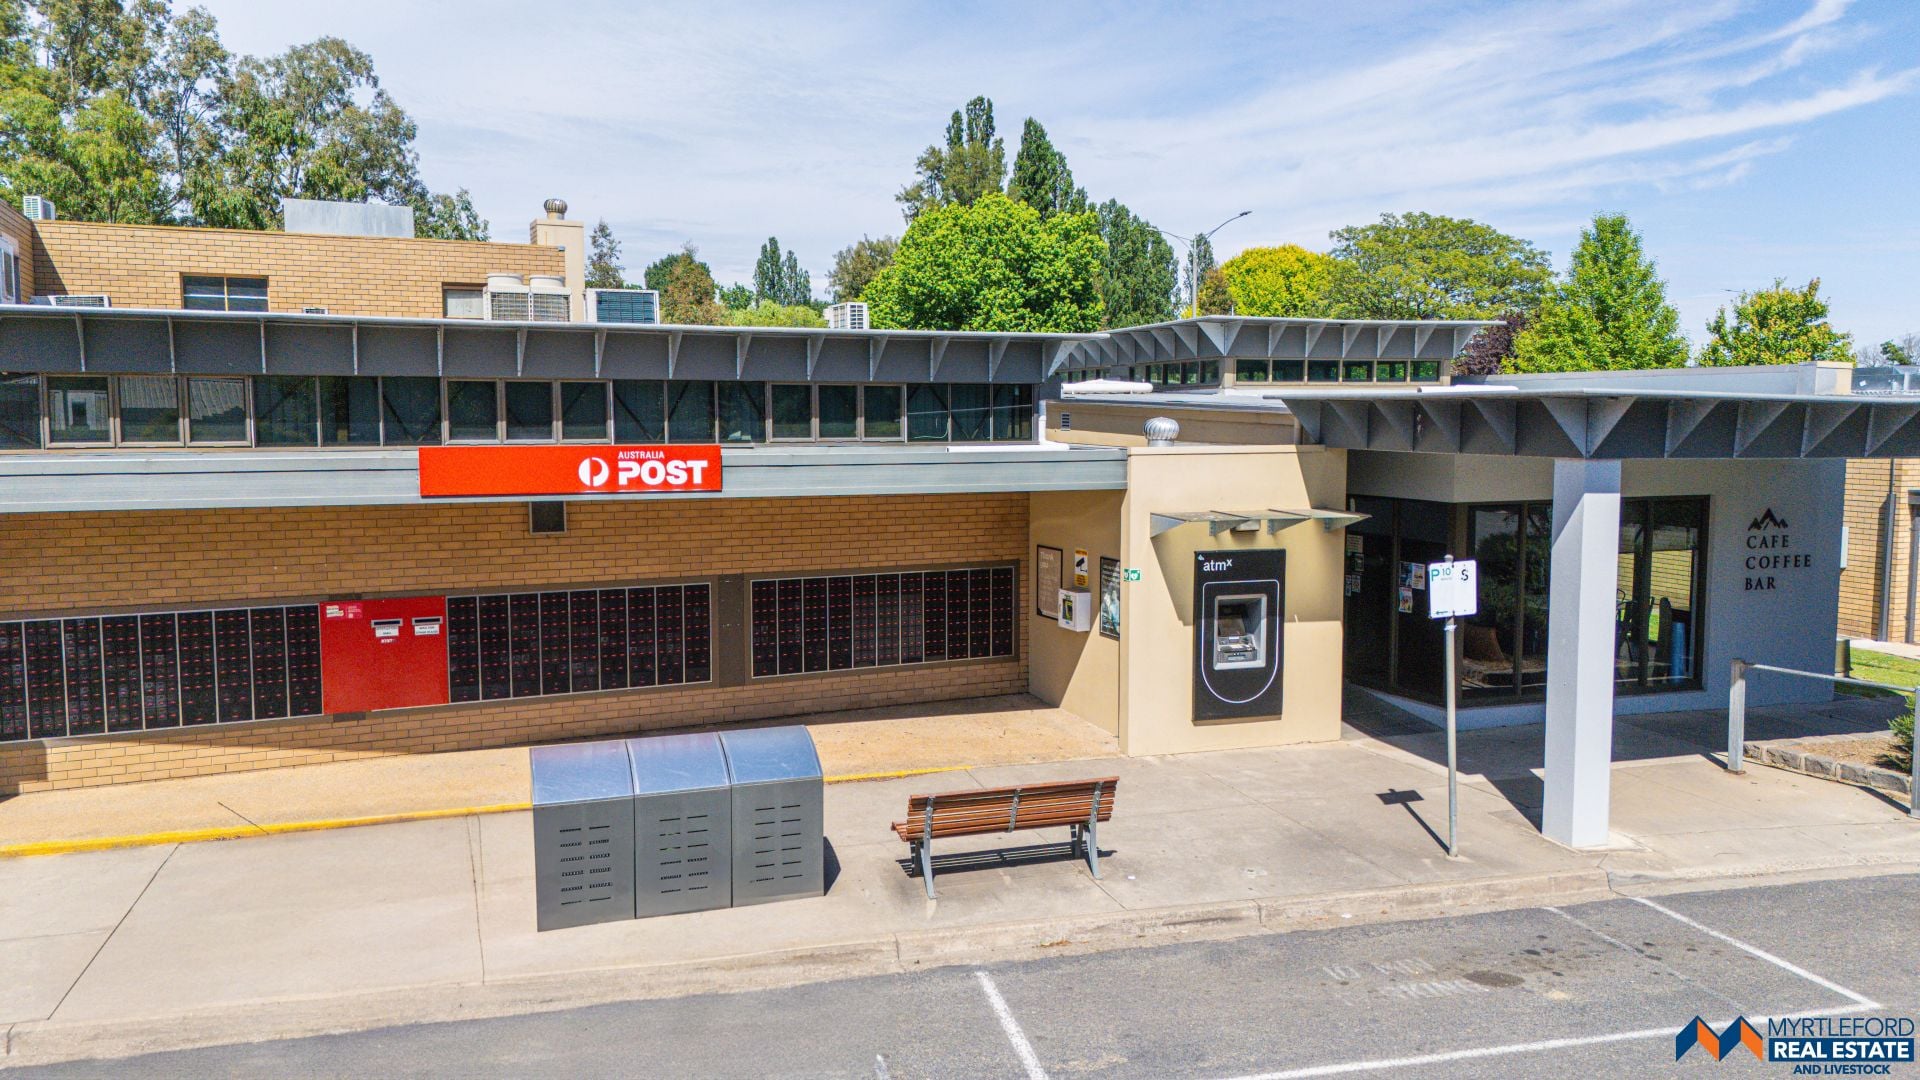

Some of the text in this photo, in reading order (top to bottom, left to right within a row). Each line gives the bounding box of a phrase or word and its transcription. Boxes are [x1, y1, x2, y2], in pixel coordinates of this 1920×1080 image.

[618, 451, 665, 459] AUSTRALIA
[618, 460, 708, 485] POST
[1746, 535, 1789, 549] CAFE
[1745, 554, 1811, 570] COFFEE
[1431, 569, 1440, 582] P
[1442, 567, 1452, 576] 10
[1461, 569, 1469, 581] S
[1745, 576, 1776, 591] BAR
